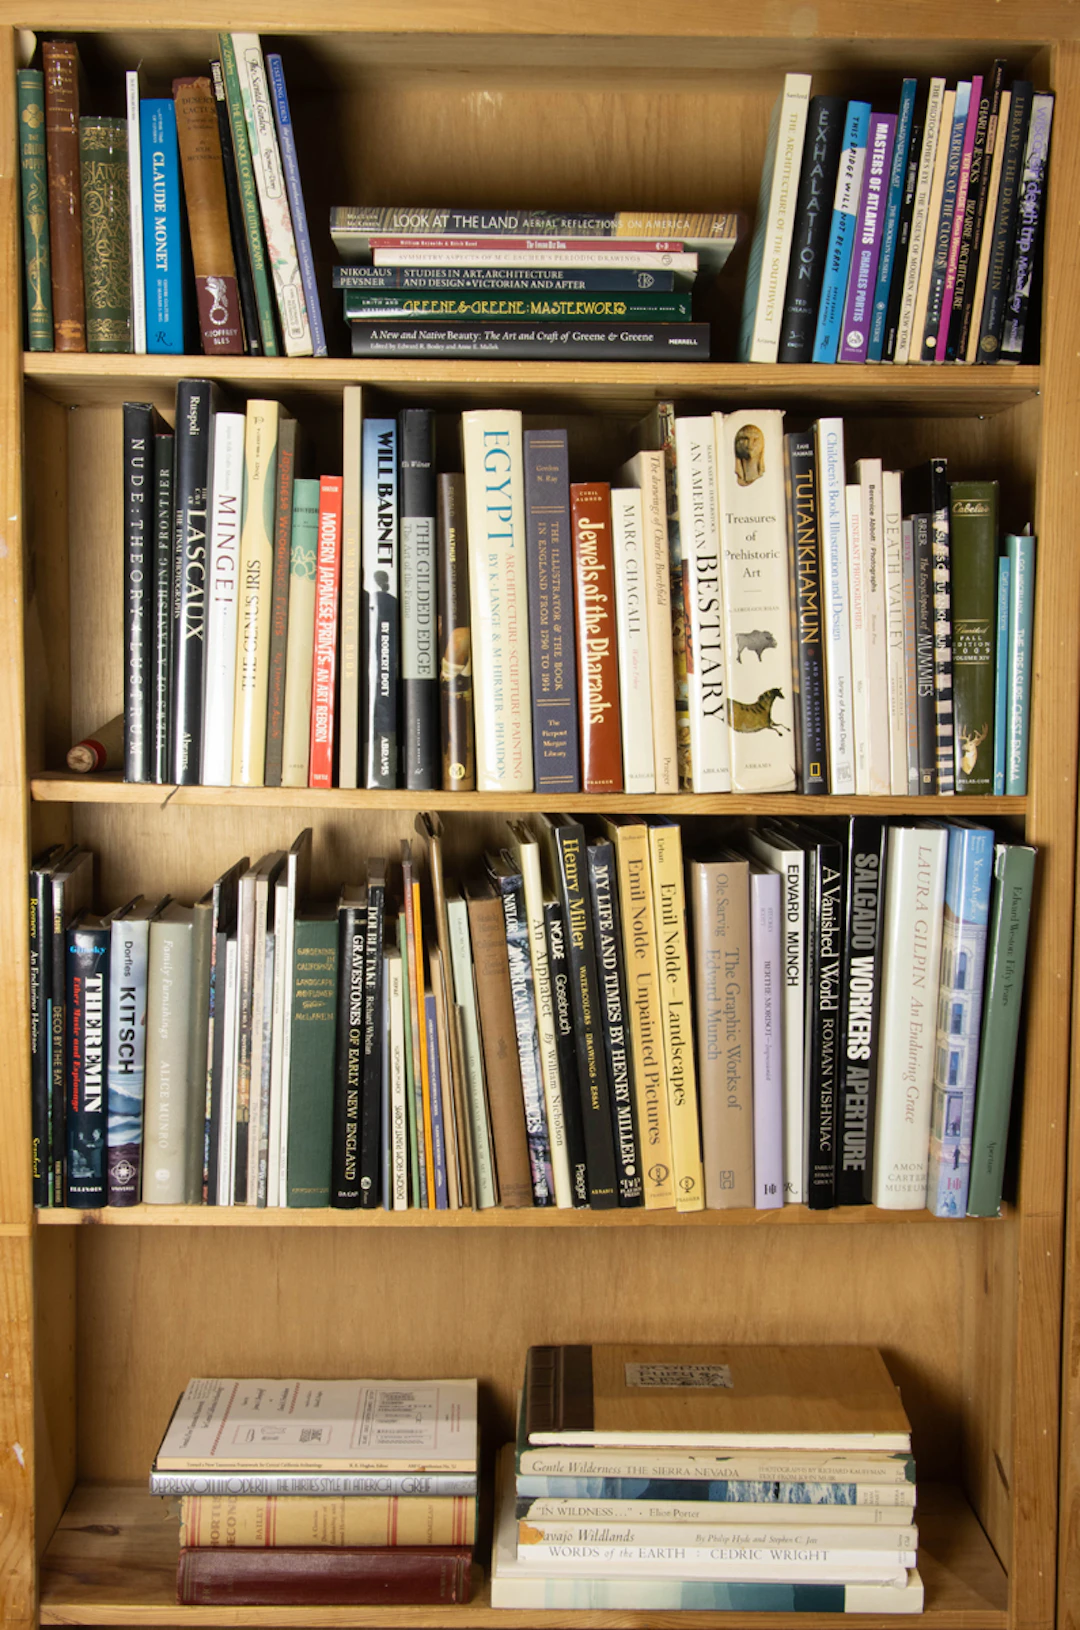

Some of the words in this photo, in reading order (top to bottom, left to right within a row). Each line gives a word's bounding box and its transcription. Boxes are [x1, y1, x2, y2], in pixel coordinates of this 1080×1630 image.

[272, 59, 285, 99] VISITING
[278, 100, 288, 123] EDEN
[870, 123, 889, 175] MASTERS
[948, 122, 964, 177] WARRIORS
[152, 151, 166, 213] CLAUDE
[868, 176, 881, 192] OF
[946, 179, 956, 194] OF
[861, 192, 879, 245] ATLANTIS
[943, 198, 954, 217] THE
[154, 215, 169, 272] MONET
[398, 253, 444, 261] SYMMETRY
[445, 253, 477, 261] ASPECTS
[478, 253, 492, 261] OF
[597, 255, 641, 263] DRAWINGS
[936, 221, 952, 266] CLOUDS
[340, 268, 392, 277] NIKOLAUS
[340, 278, 385, 286] PEVSNER
[403, 279, 427, 287] AND
[428, 279, 466, 288] DESIGN
[472, 280, 529, 289] VICTORIAN
[530, 281, 553, 289] AND
[555, 281, 586, 290] AFTER
[404, 269, 446, 277] STUDIES
[448, 269, 460, 277] IN
[463, 269, 485, 278] ART,
[485, 269, 564, 280] ARCHITECTURE
[857, 250, 872, 288] CHARLES
[852, 290, 867, 323] PORTIS
[370, 331, 378, 340] A
[379, 331, 398, 340] New
[400, 331, 417, 340] and
[418, 331, 446, 340] Native
[447, 331, 482, 342] Beauty:
[484, 331, 500, 340] The
[502, 331, 517, 340] Art
[518, 331, 534, 341] and
[536, 331, 559, 344] Craft
[560, 331, 572, 342] of
[572, 331, 605, 341] Greene
[607, 332, 618, 341] &
[620, 332, 654, 341] Greene
[187, 395, 200, 436] Ruspoli
[377, 431, 393, 480] WILL
[690, 441, 702, 462] AN
[826, 431, 839, 489] Children's
[483, 430, 515, 548] EGYPT
[692, 467, 706, 550] AMERICAN
[828, 489, 840, 519] Book
[868, 484, 876, 516] Berenice
[319, 512, 337, 563] MODERN
[377, 482, 393, 568] BARNET
[416, 521, 430, 556] THE
[538, 521, 547, 535] IN
[622, 504, 637, 552] MARC
[725, 513, 777, 524] Treasures
[745, 530, 758, 542] of
[869, 517, 877, 542] Abbott
[917, 518, 927, 546] BRIER
[538, 539, 548, 591] ENGLAND
[577, 517, 606, 581] Jewels
[724, 549, 780, 560] Prehistoric
[795, 469, 819, 644] TUTANKHAMUN
[829, 521, 843, 578] Illustration
[185, 508, 207, 641] LASCAUX
[742, 568, 761, 578] Art
[832, 580, 842, 599] and
[869, 547, 878, 593] Photographs
[318, 566, 335, 618] JAPANESE
[416, 560, 430, 625] GILDED
[540, 595, 549, 625] FROM
[580, 584, 608, 603] of
[626, 559, 640, 639] CHAGALL
[380, 621, 390, 633] BY
[584, 605, 609, 635] the
[696, 554, 725, 723] BESTIARY
[831, 602, 845, 642] Design
[317, 622, 333, 666] PRINTS:
[380, 634, 390, 672] ROBERT
[417, 628, 431, 675] EDGE
[541, 654, 549, 669] TO
[316, 667, 329, 682] AN
[316, 684, 328, 703] ART
[380, 674, 389, 697] DOTY
[541, 672, 550, 692] 1914
[586, 637, 612, 724] Pharaohs
[837, 675, 845, 703] Library
[315, 706, 328, 743] REBORN
[838, 708, 847, 732] Applied
[380, 736, 390, 776] ABRAMS
[562, 838, 580, 892] Henry
[657, 838, 666, 863] Urban
[593, 864, 610, 891] MY
[627, 858, 645, 902] Emil
[787, 864, 799, 923] EDVARD
[822, 865, 841, 884] A
[915, 845, 932, 911] LAURA
[597, 894, 614, 930] LIFE
[660, 882, 679, 926] Emil
[820, 885, 841, 958] Vanished
[851, 853, 879, 950] SALGADO
[568, 897, 586, 950] Miller
[632, 905, 649, 959] Nolde
[124, 940, 134, 977] Dorfles
[600, 933, 617, 970] AND
[663, 930, 681, 984] Nolde
[786, 931, 799, 987] MUNCH
[912, 919, 928, 989] GILPIN
[603, 972, 622, 1023] TIMES
[819, 961, 840, 1011] World
[910, 995, 923, 1017] An
[635, 972, 660, 1067] Unpainted
[847, 955, 874, 1060] WORKERS
[84, 972, 103, 1113] THEREMIN
[118, 987, 135, 1074] KITSCH
[609, 1026, 624, 1046] BY
[666, 1000, 687, 1107] Landscapes
[902, 1021, 923, 1082] Enduring
[611, 1049, 631, 1102] HENRY
[645, 1071, 662, 1146] Pictures
[843, 1066, 870, 1170] APERTURE
[905, 1086, 920, 1124] Grace
[617, 1105, 637, 1166] MILLER
[893, 1163, 924, 1171] AMON
[531, 1460, 564, 1474] Gentle
[568, 1461, 621, 1475] Wilderness
[626, 1466, 648, 1475] THE
[651, 1466, 691, 1477] SIERRA
[695, 1467, 739, 1478] NEVADA
[255, 1506, 263, 1540] BAILEY
[549, 1546, 599, 1557] WORDS
[604, 1547, 615, 1559] of
[619, 1547, 633, 1557] the
[638, 1547, 685, 1559] EARTH
[710, 1549, 763, 1560] CEDRIC
[769, 1550, 830, 1561] WRIGHT
